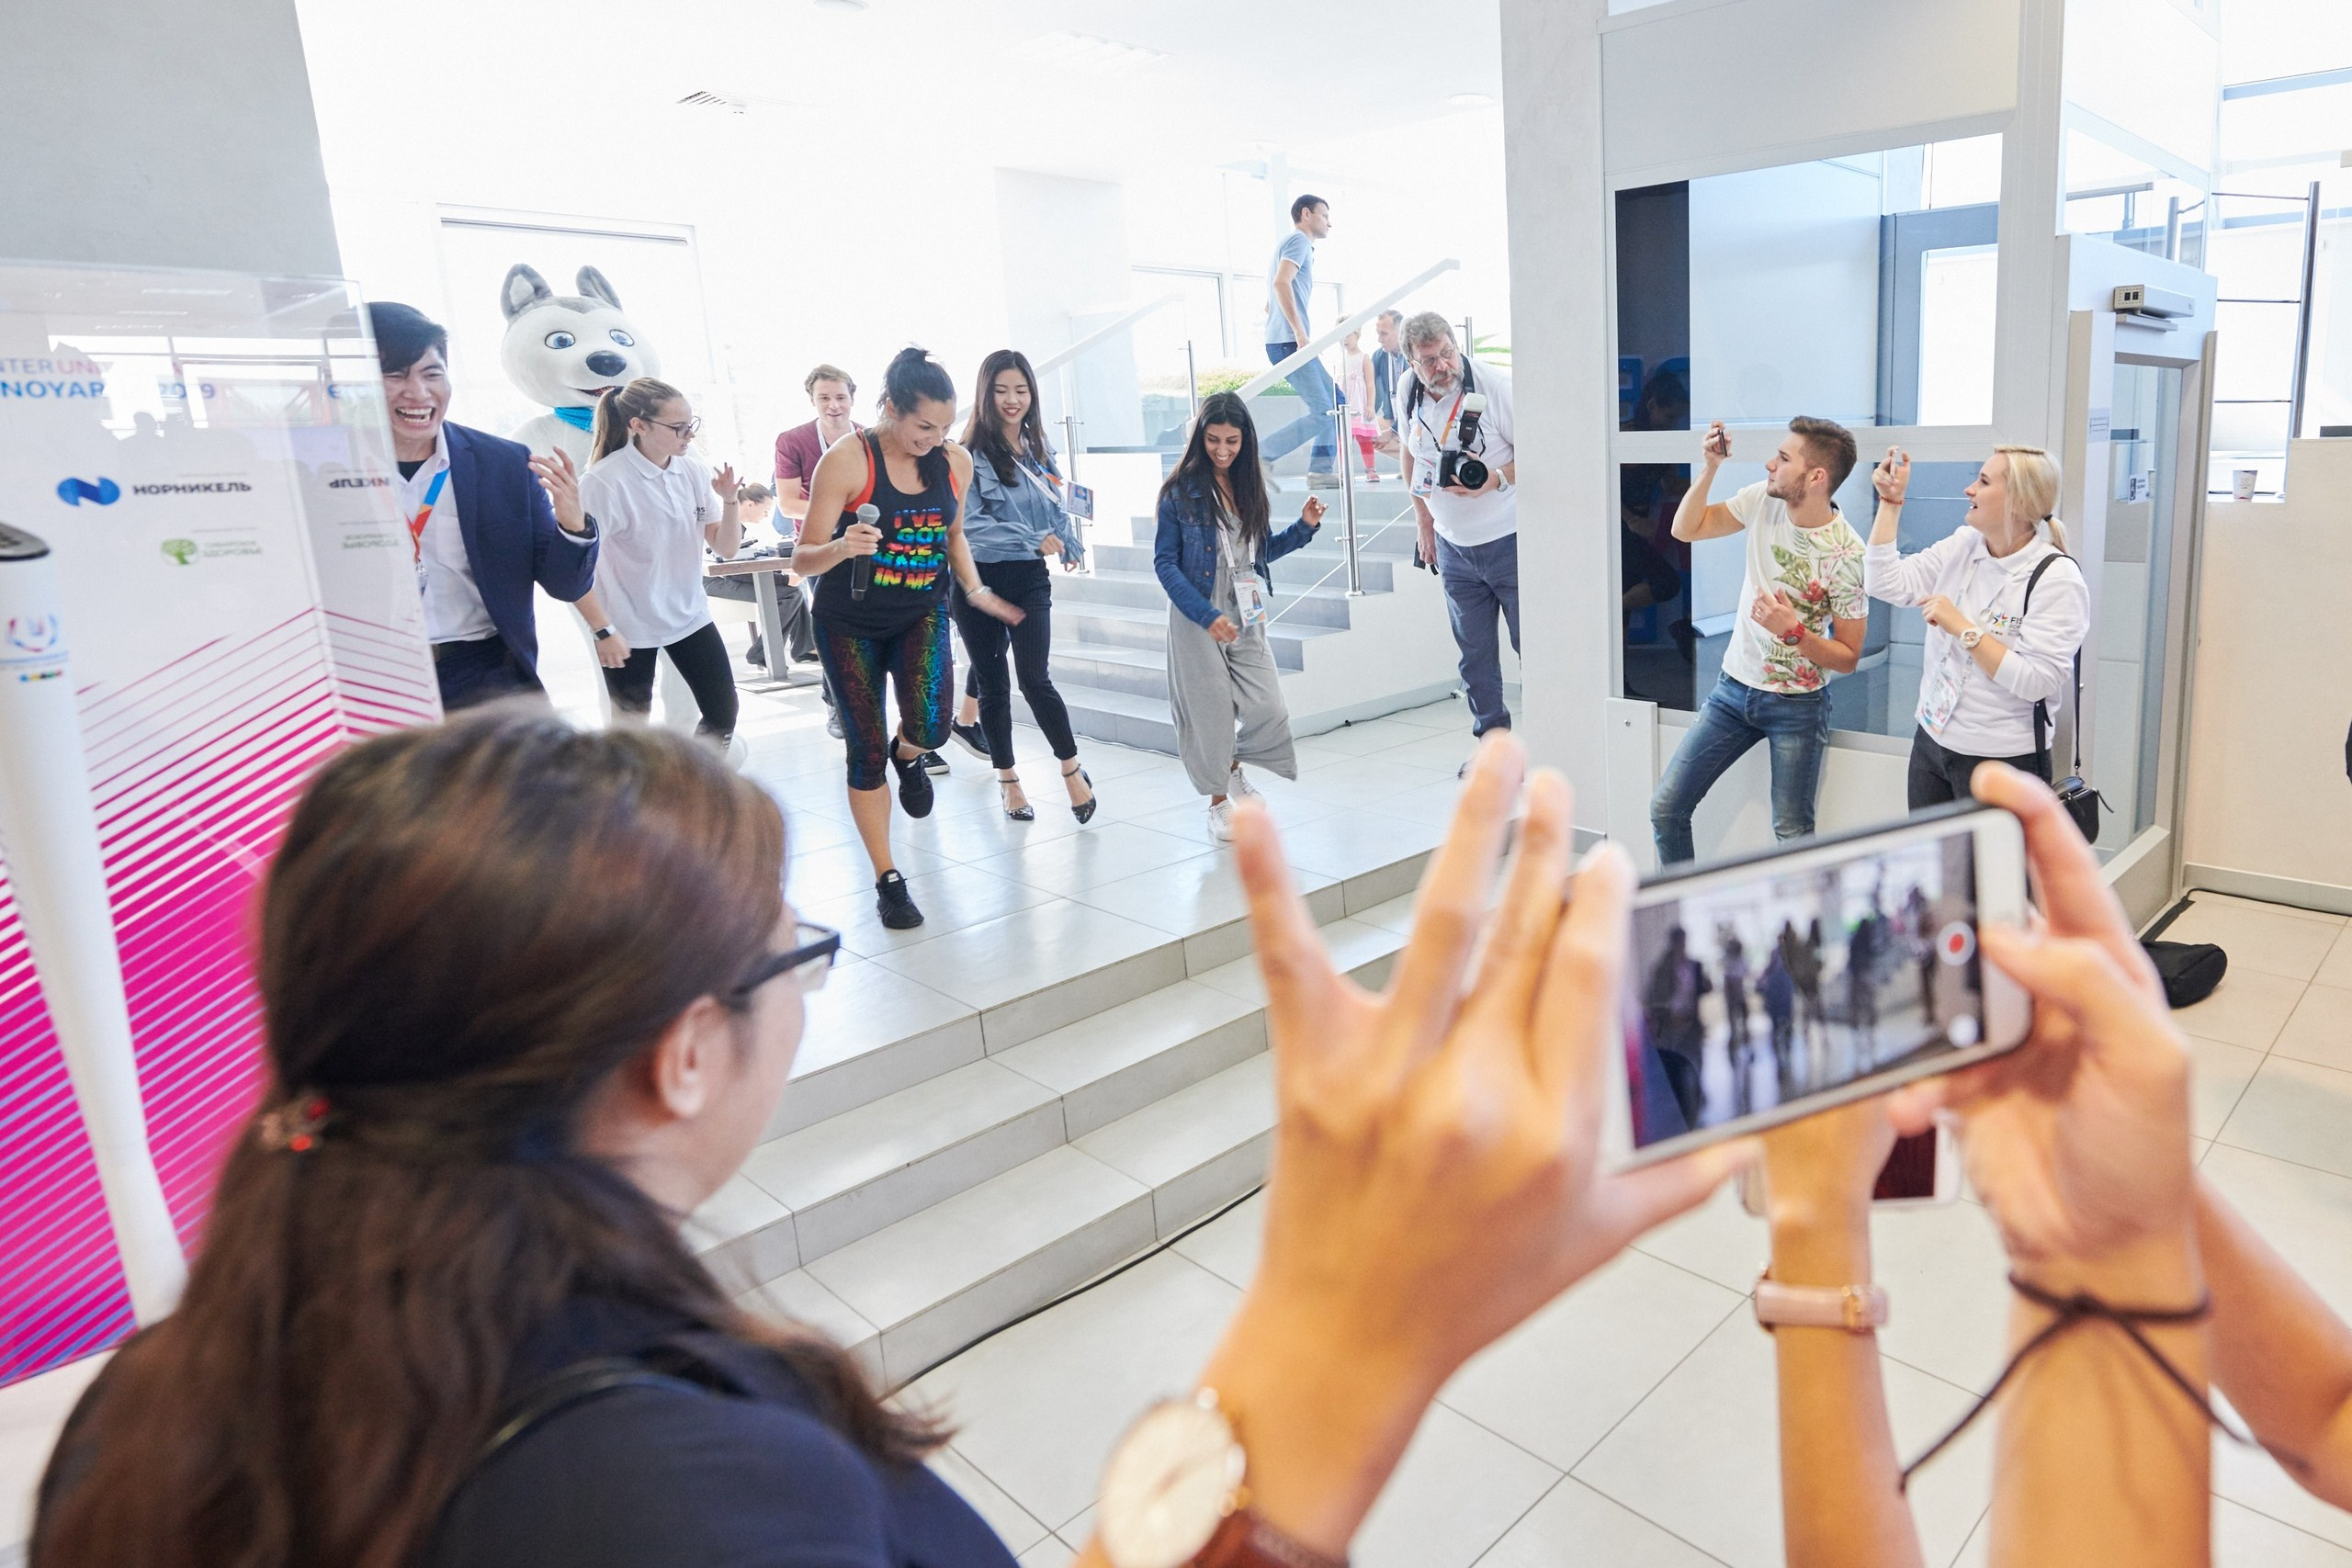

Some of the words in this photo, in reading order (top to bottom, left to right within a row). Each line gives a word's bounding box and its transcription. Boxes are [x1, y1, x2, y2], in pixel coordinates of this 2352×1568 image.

[0, 358, 52, 374] TER
[133, 482, 252, 494] НОРНИКЕЛЬ
[893, 507, 943, 529] I'VE
[897, 525, 947, 544] GOT
[874, 568, 902, 587] IN
[904, 572, 937, 590] ME
